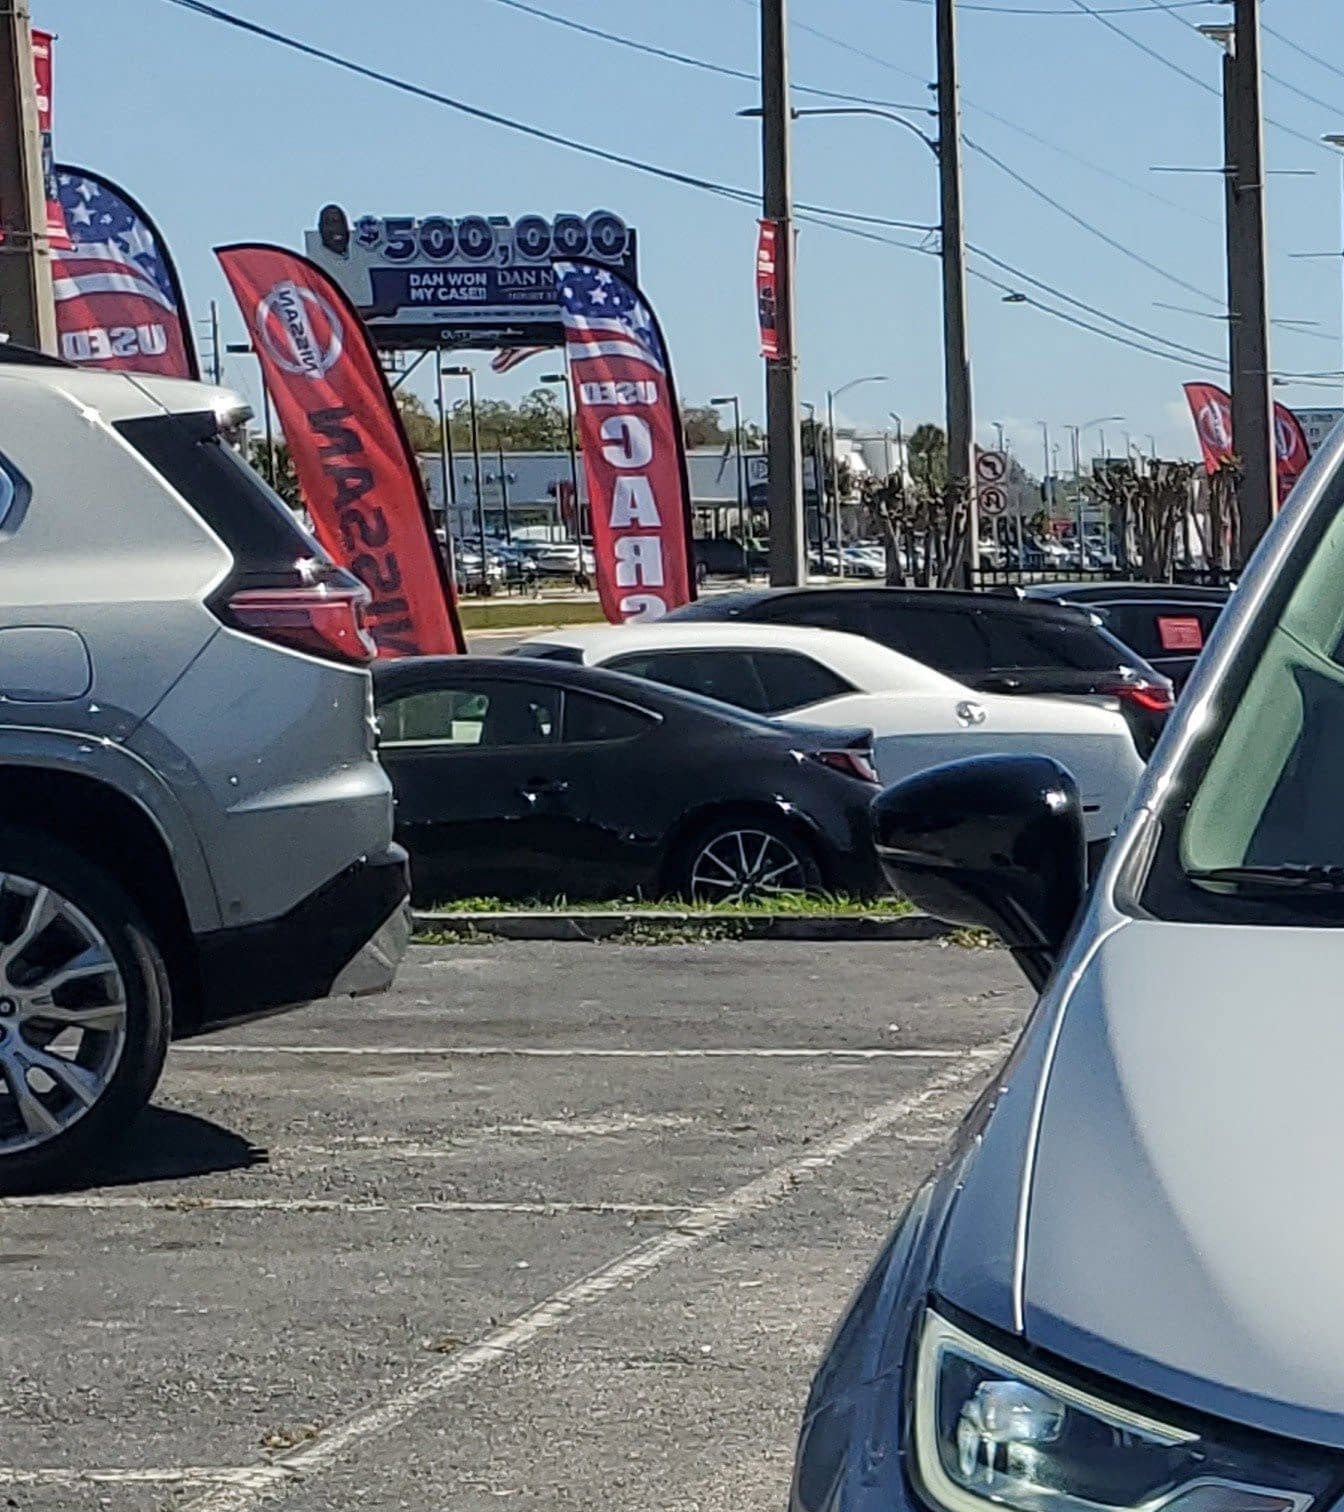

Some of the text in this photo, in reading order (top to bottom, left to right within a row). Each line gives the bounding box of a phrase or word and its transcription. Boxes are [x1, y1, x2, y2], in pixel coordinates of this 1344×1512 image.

[355, 213, 628, 263] $500,000
[409, 272, 487, 286] DAN WON
[498, 270, 536, 286] DAN
[410, 287, 434, 300] MY
